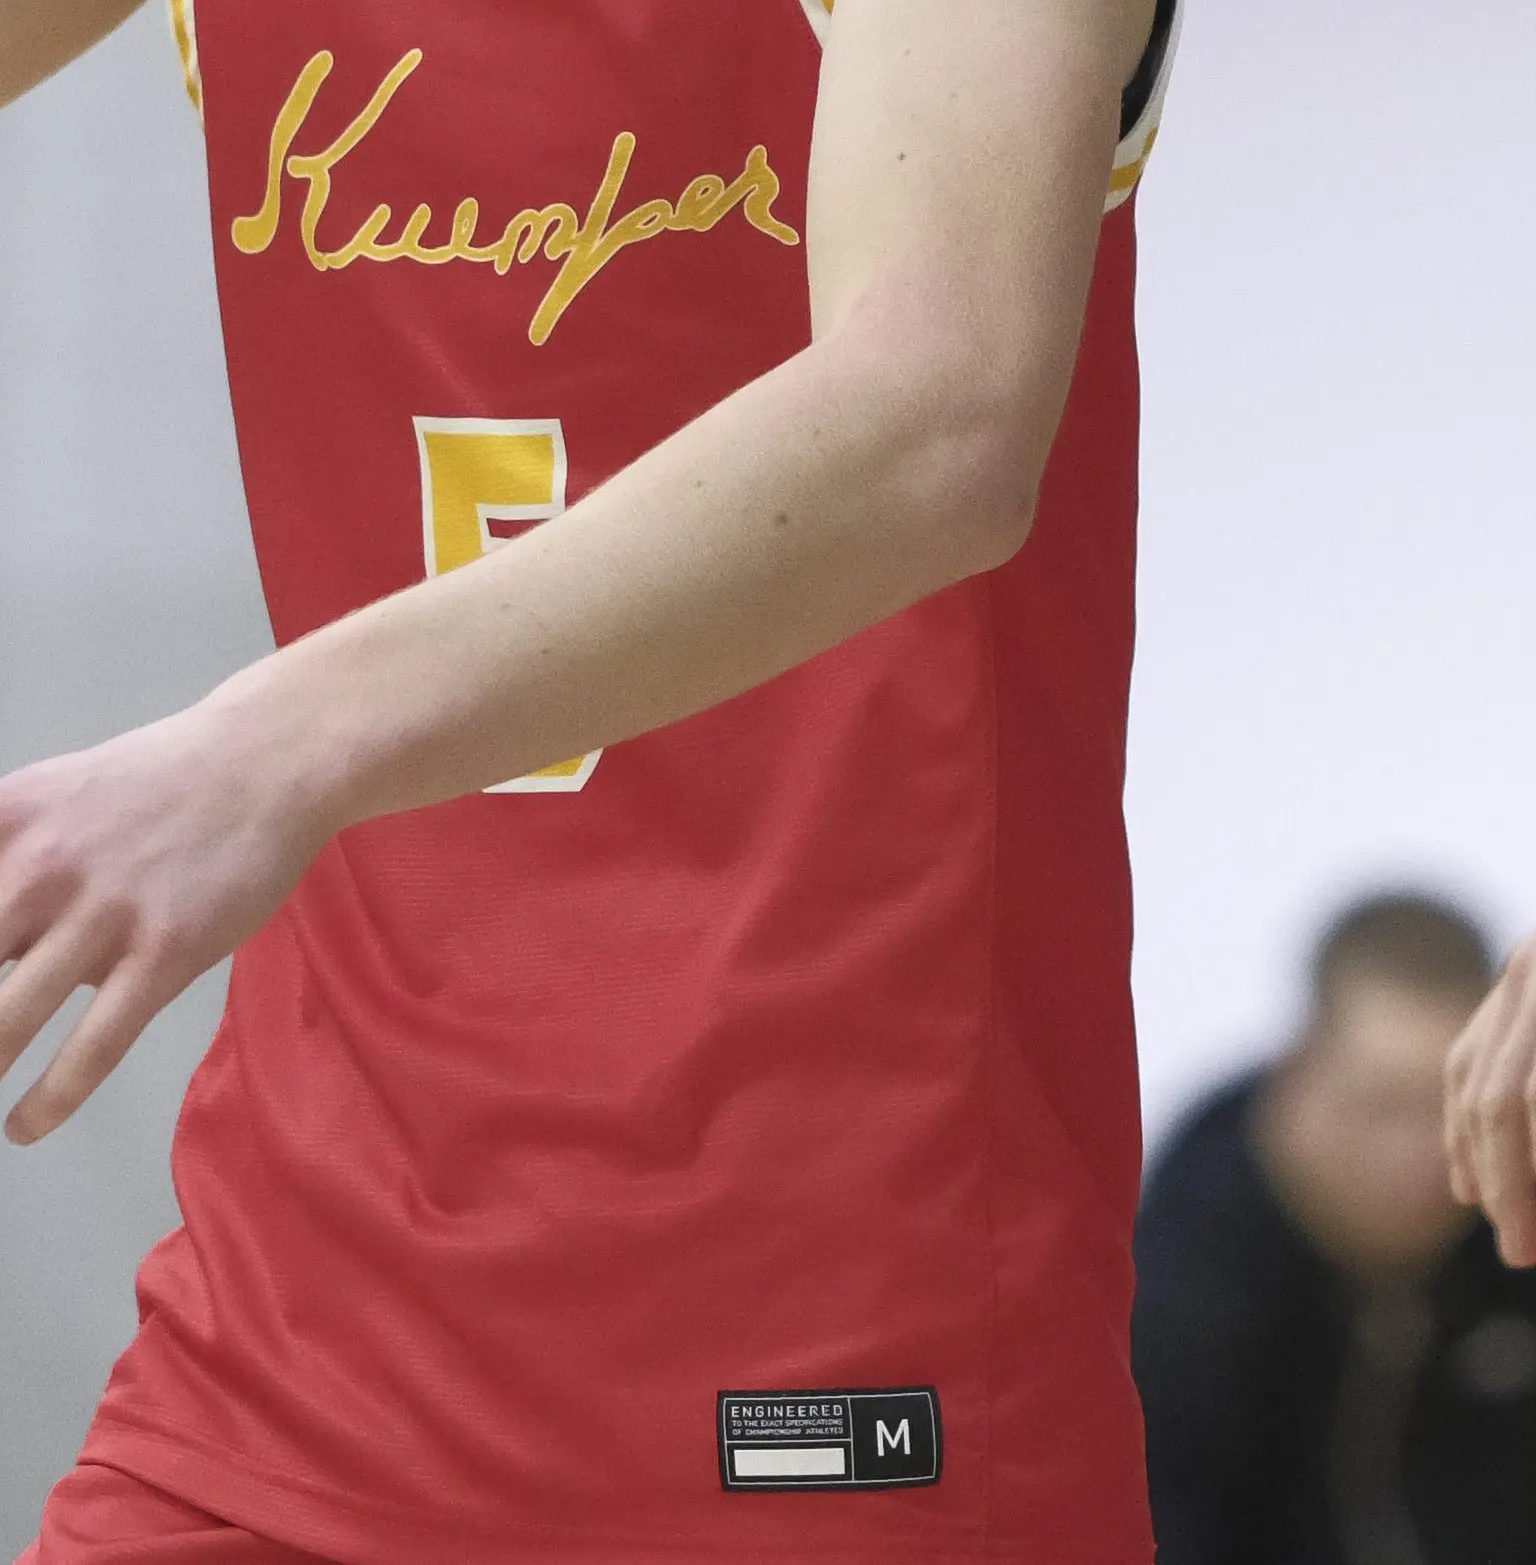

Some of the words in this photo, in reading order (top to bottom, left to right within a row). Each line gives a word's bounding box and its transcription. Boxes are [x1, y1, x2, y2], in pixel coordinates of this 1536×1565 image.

[232, 48, 802, 346] Kuemper
[731, 1405, 843, 1417] ENGINEERED
[876, 1419, 911, 1456] M
